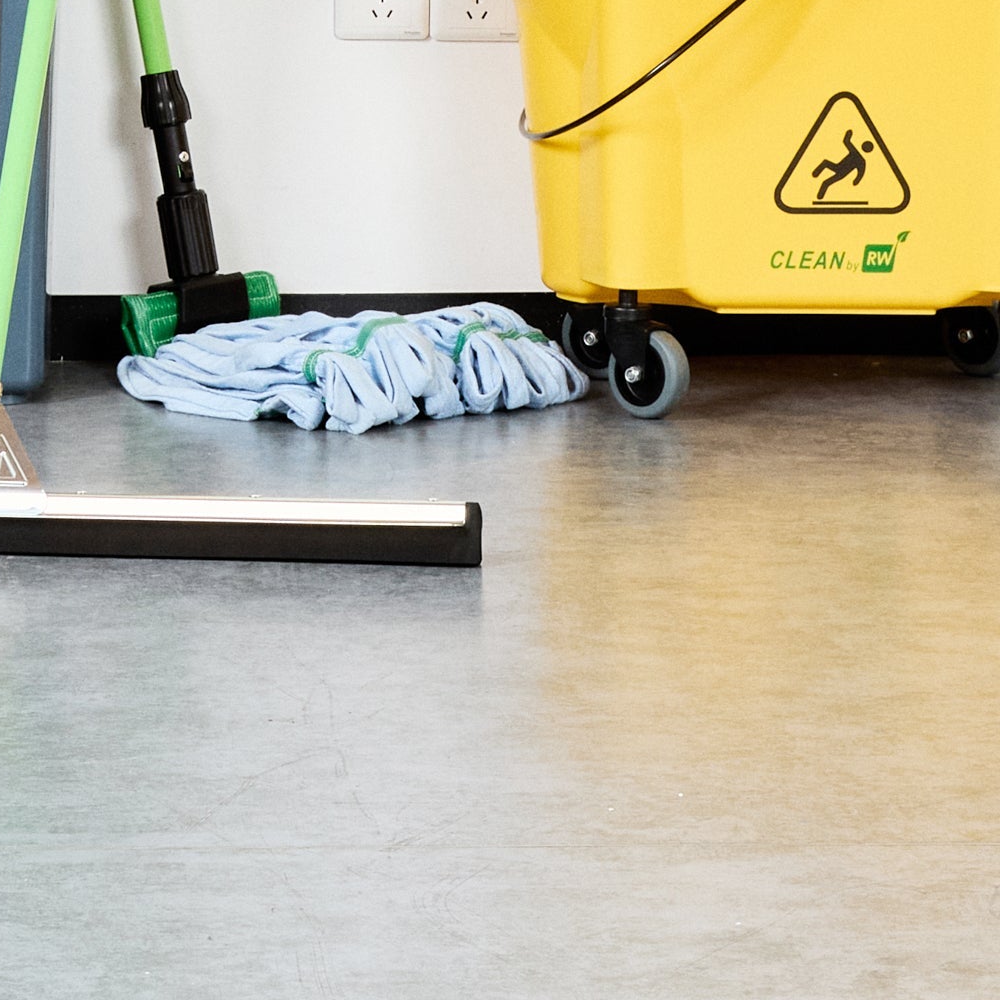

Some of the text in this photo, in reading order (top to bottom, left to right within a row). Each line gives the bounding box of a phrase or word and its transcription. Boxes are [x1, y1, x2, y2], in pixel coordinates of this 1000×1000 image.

[770, 250, 893, 273] CLEAN by RW
